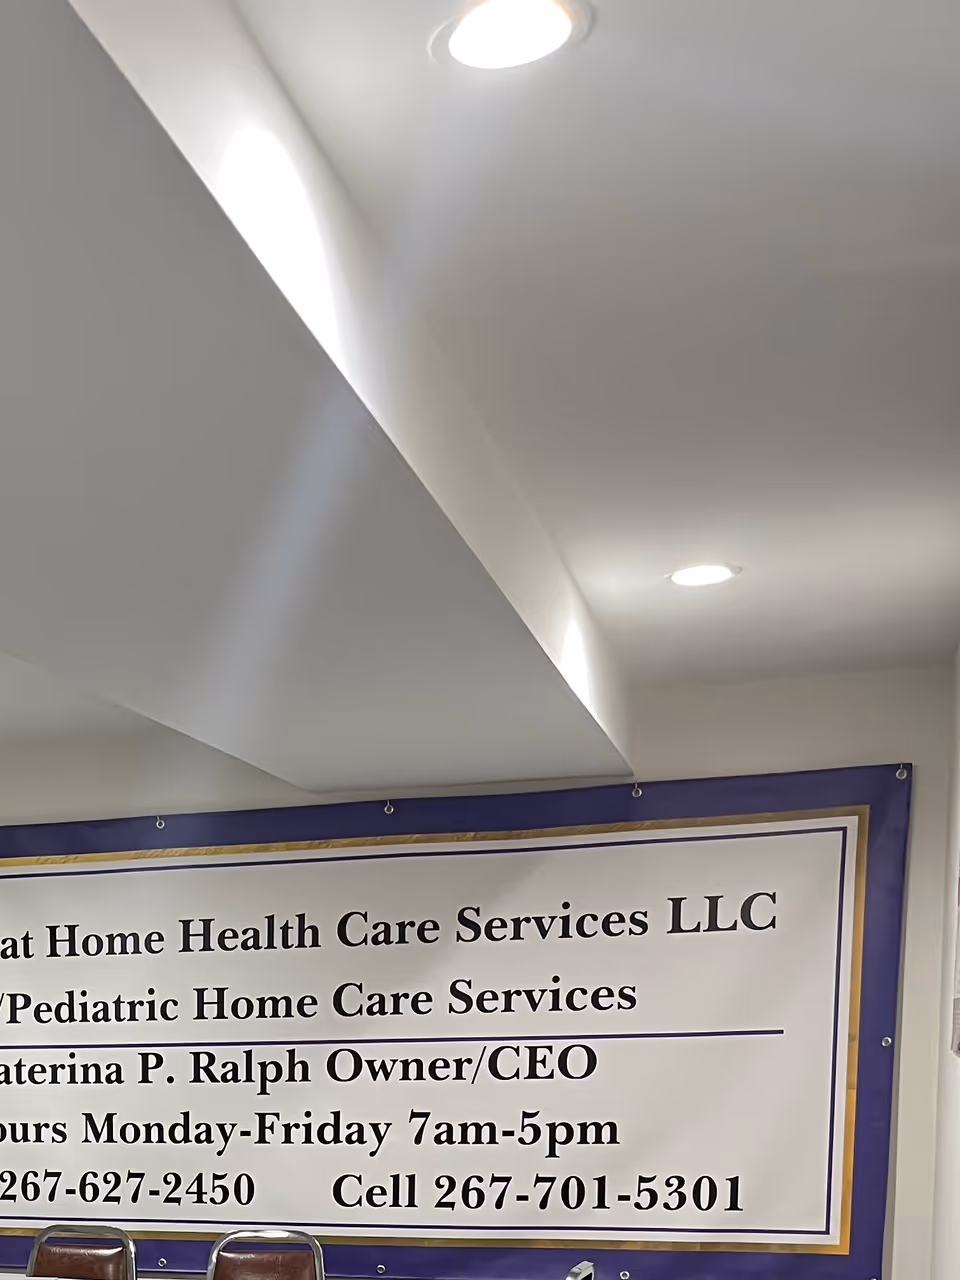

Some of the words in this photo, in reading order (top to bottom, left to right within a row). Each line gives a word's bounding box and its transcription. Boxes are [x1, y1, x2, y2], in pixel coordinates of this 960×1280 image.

[45, 924, 165, 958] Home
[178, 912, 322, 953] Health
[336, 910, 440, 948] Care
[455, 901, 649, 943] Services
[666, 891, 777, 934] LLC
[192, 986, 318, 1021] Home
[332, 982, 433, 1018] Care
[448, 975, 637, 1015] Services
[137, 1052, 175, 1084] P.
[188, 1048, 312, 1096] Ralph
[326, 1044, 598, 1085] Owner/CEO
[81, 1110, 393, 1158] Monday-Friday
[408, 1108, 621, 1159] 7am-5pm
[0, 1168, 255, 1207] 267-627-2450
[332, 1173, 419, 1208] Cell
[434, 1172, 744, 1212] 267-701-5301
